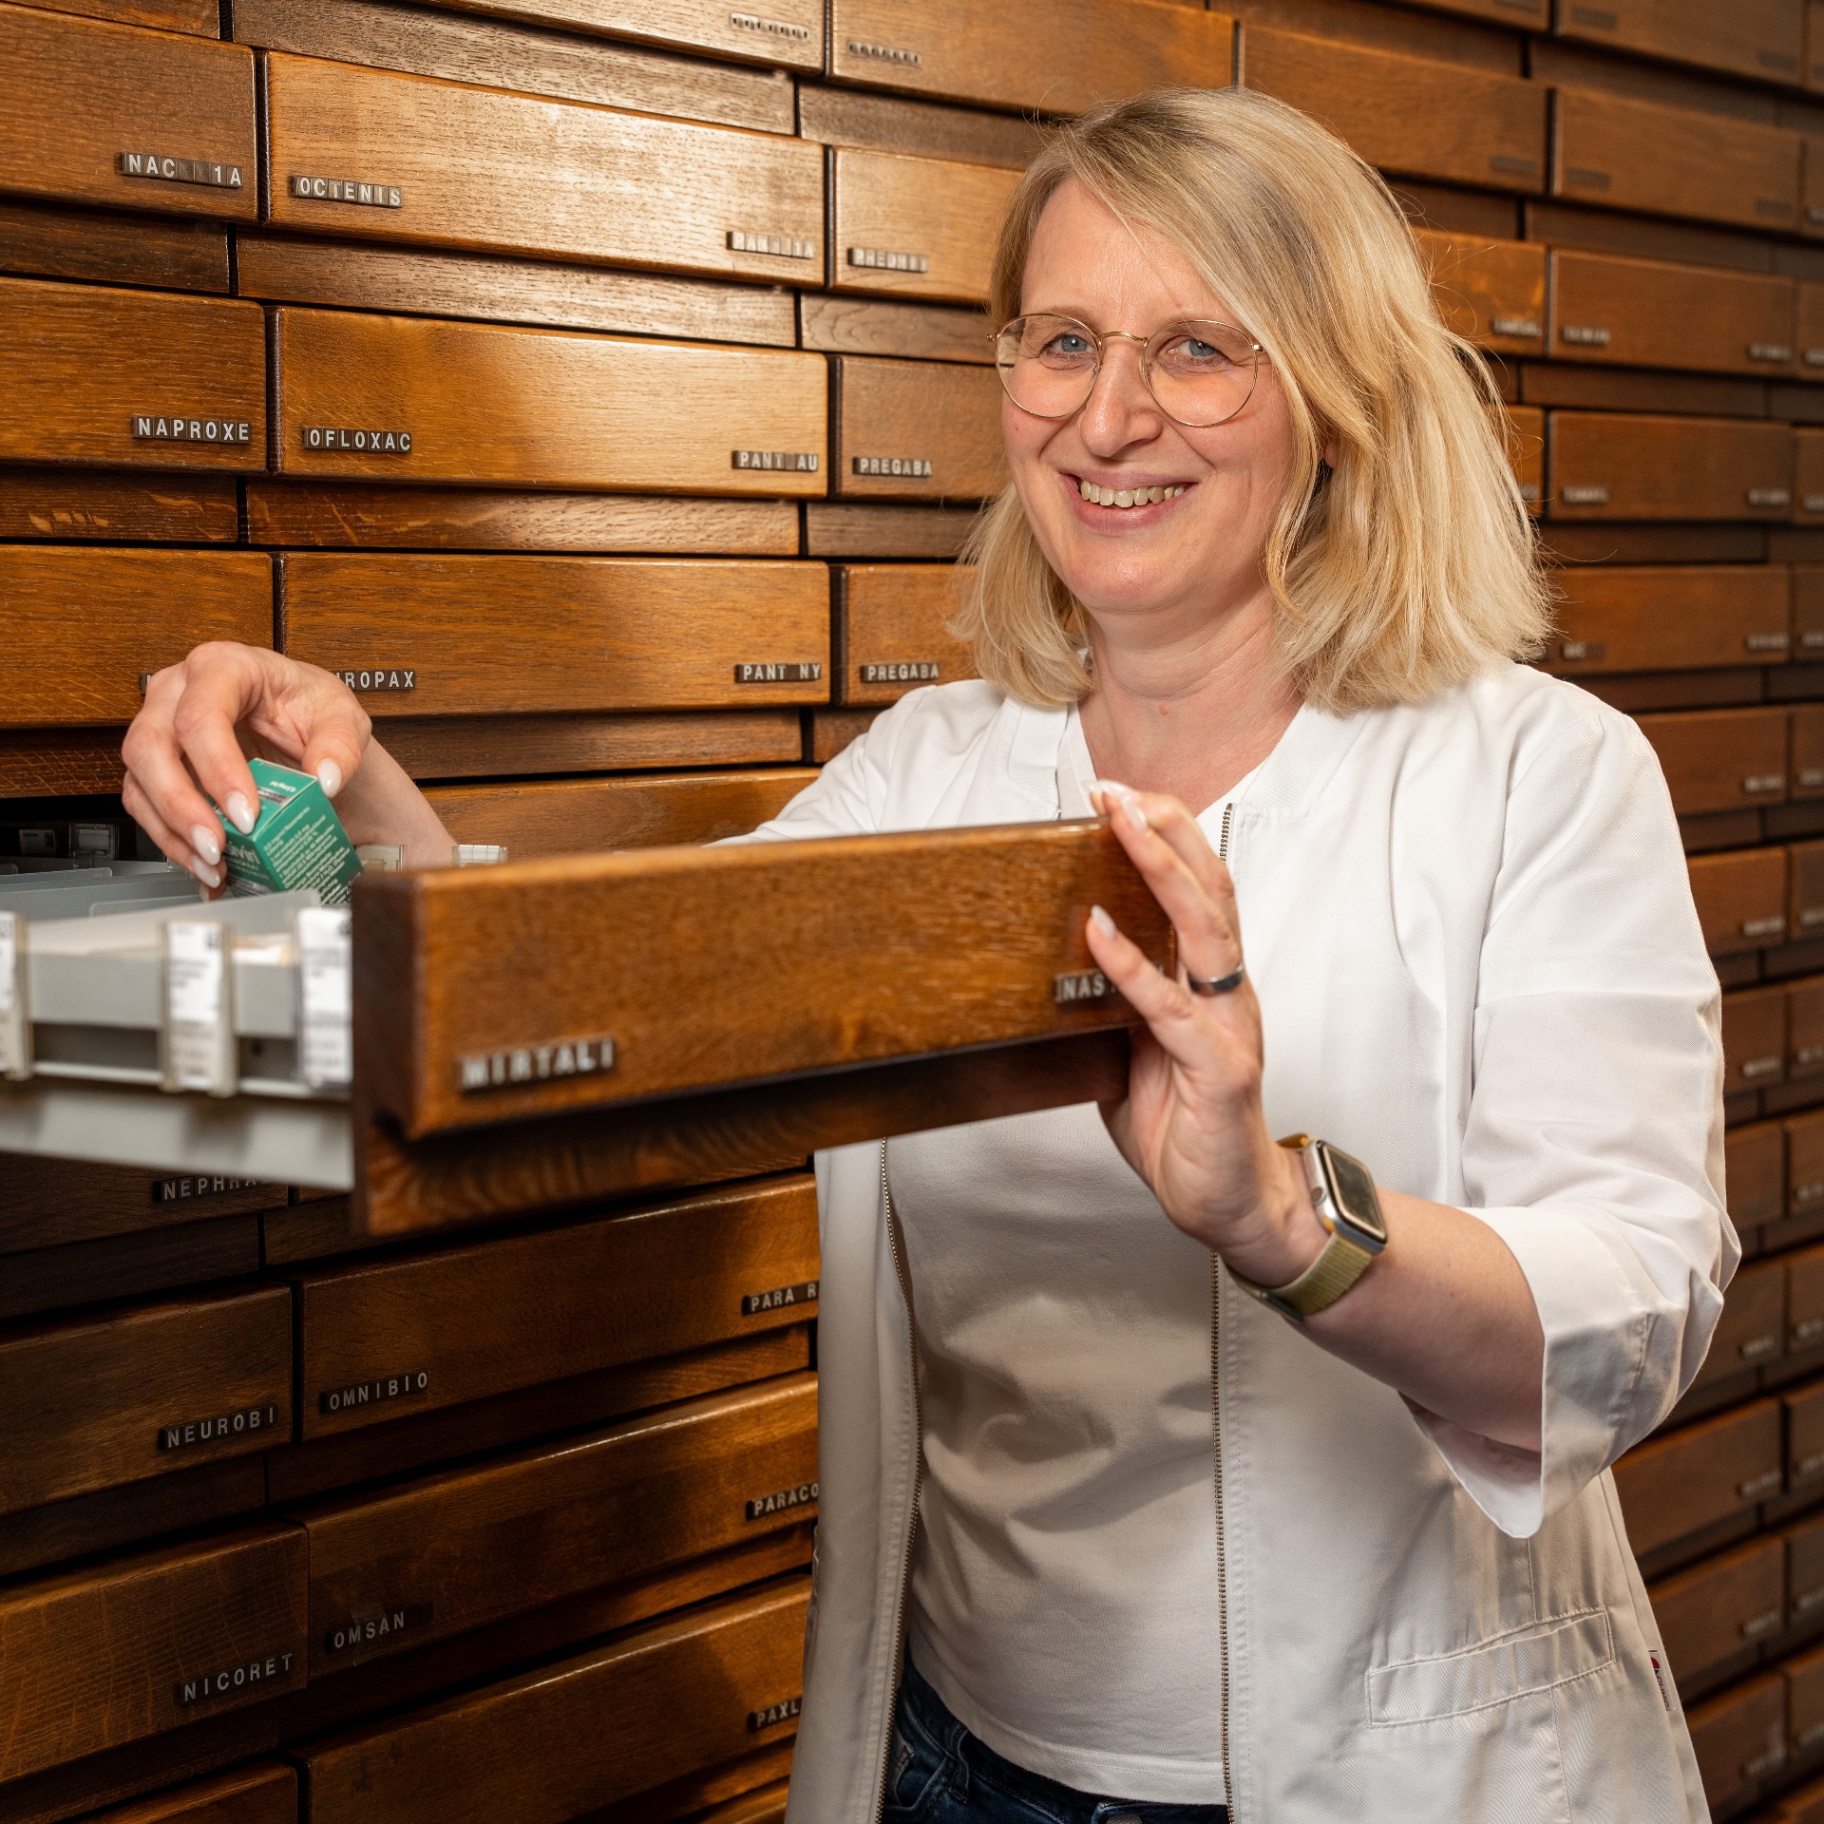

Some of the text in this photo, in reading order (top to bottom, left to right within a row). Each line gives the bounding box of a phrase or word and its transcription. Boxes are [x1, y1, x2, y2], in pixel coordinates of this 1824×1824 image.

[128, 154, 242, 187] NAC 1A
[299, 177, 402, 207] OCTENIS
[138, 418, 250, 441] NAPROXE
[309, 428, 411, 451] OFLOXAC
[740, 451, 818, 471] PANT AU
[860, 457, 933, 476] PREGABA
[336, 671, 414, 689] ROPAX
[743, 662, 822, 681] PANT NY
[867, 662, 940, 681] PREGABA
[1063, 970, 1117, 1001] NAS
[163, 1175, 269, 1200] NEPHRA
[751, 1282, 817, 1312] PARA R
[329, 1372, 428, 1411] OMNIBIO
[167, 1406, 274, 1449] NEUROBI
[754, 1482, 819, 1517] PARACO
[334, 1611, 405, 1649] OMSAN
[184, 1652, 293, 1701] NICORET
[757, 1700, 800, 1727] PAXL
